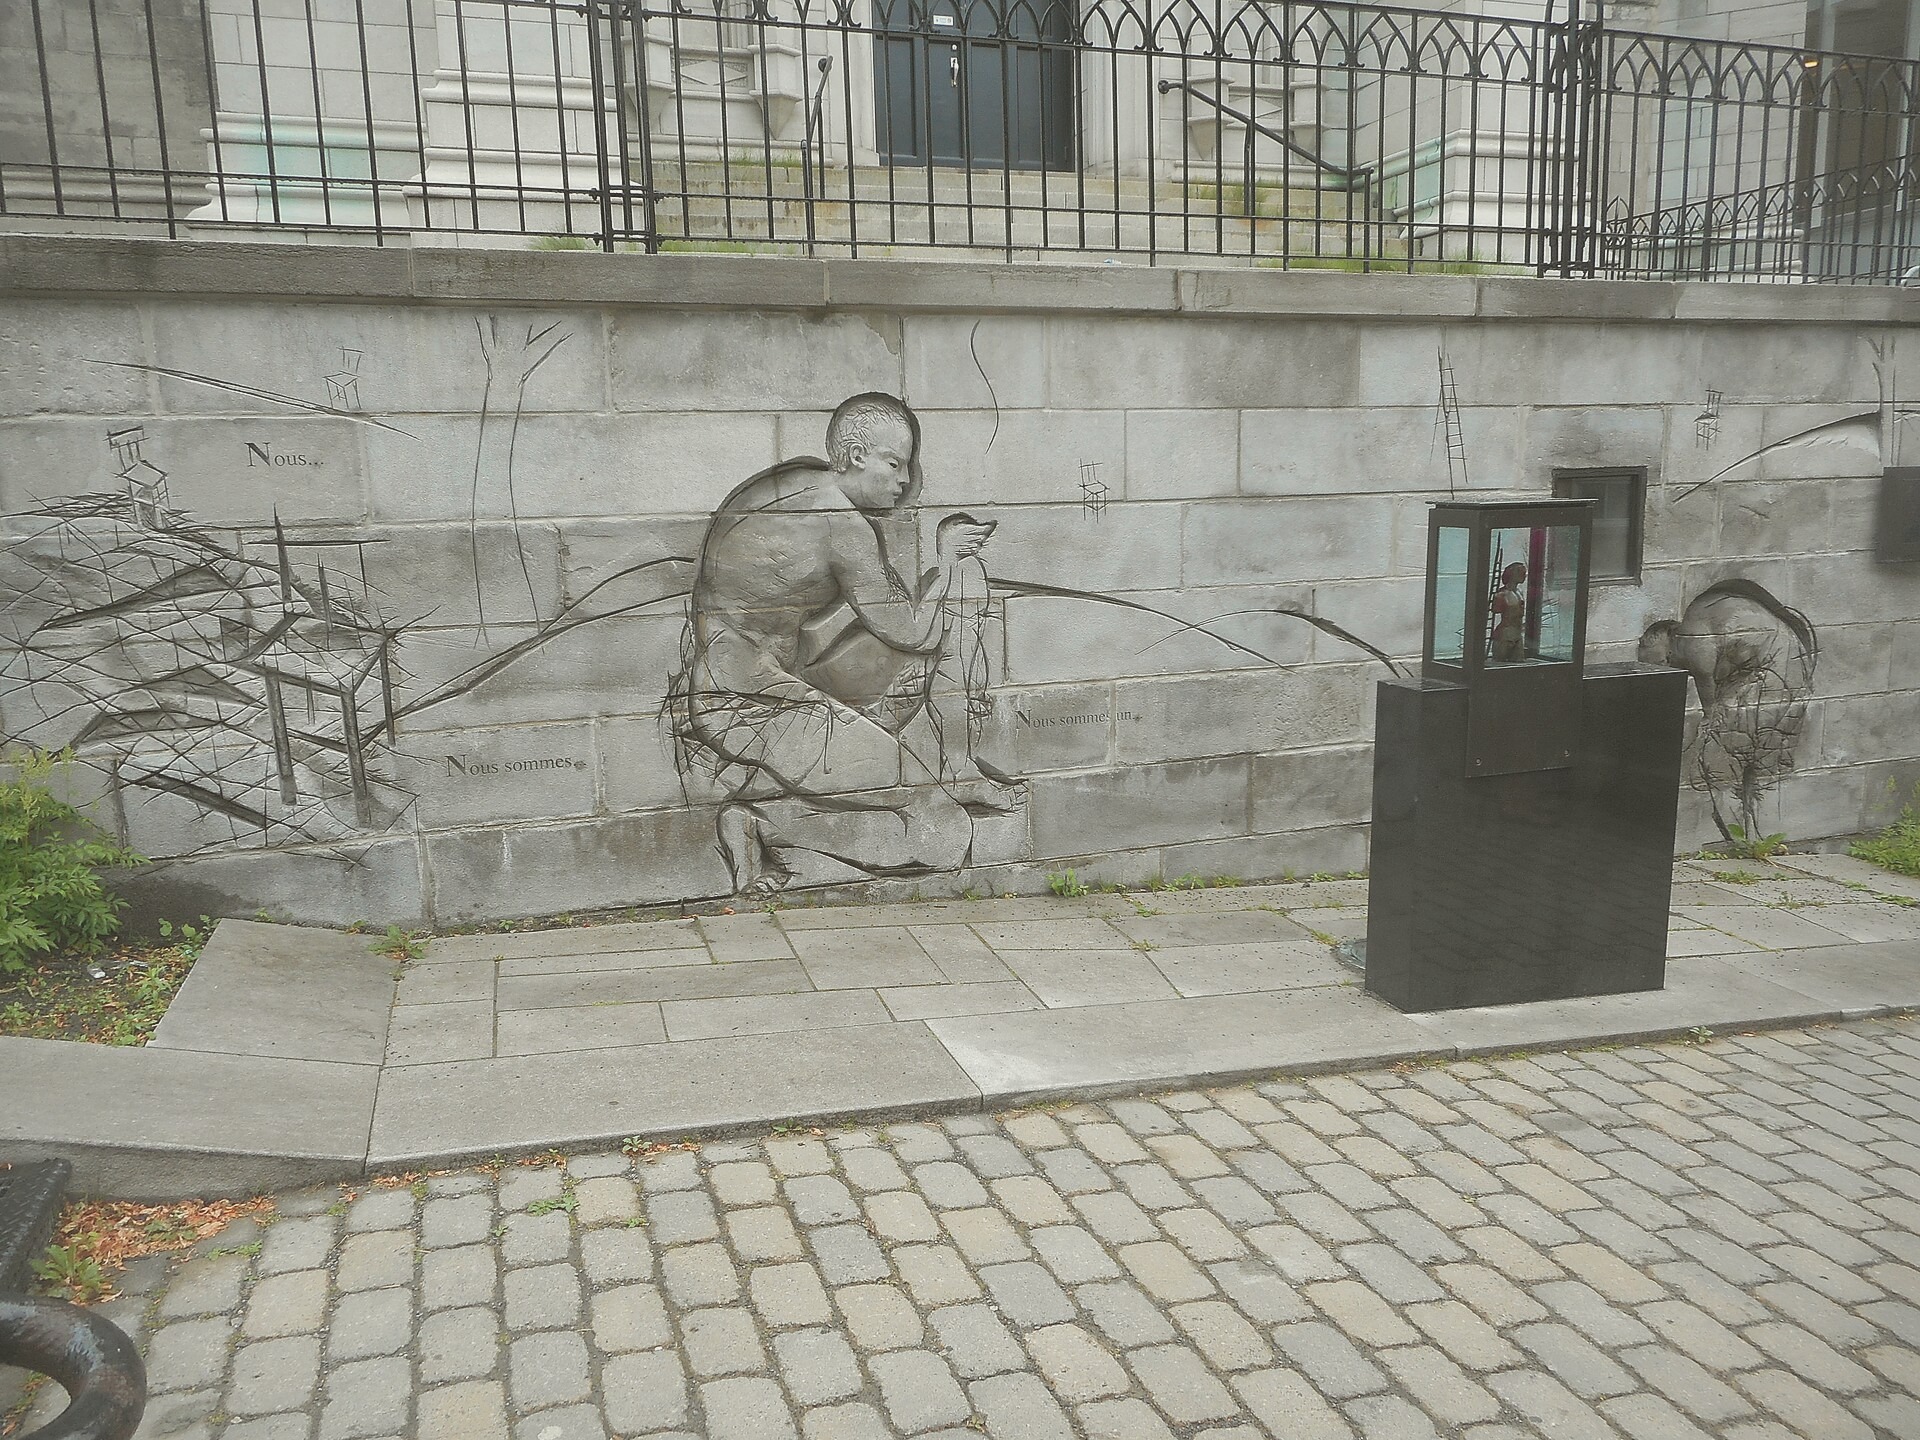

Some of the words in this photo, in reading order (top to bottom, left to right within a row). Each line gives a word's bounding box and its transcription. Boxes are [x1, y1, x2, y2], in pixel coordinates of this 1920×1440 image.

[244, 442, 324, 467] Nous...
[1014, 709, 1056, 729] Nous
[444, 754, 499, 777] Nous
